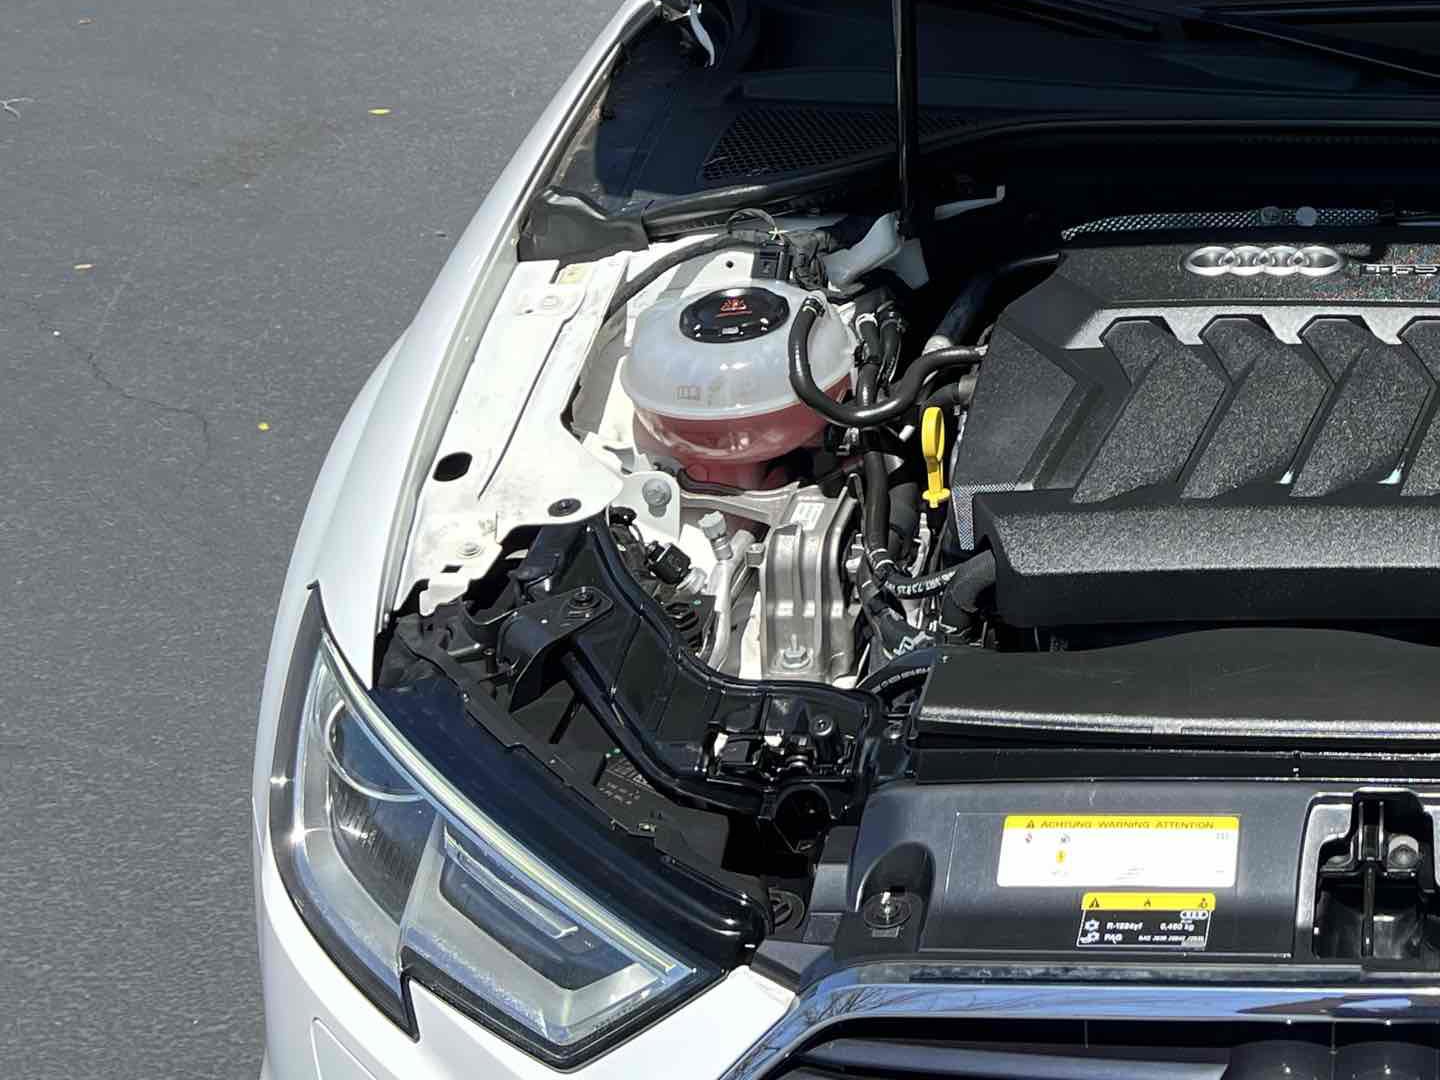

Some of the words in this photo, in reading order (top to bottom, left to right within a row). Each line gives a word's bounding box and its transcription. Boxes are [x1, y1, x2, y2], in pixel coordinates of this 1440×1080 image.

[1040, 820, 1092, 829] ACHTUNG
[1098, 820, 1150, 829] WARNING
[1155, 820, 1214, 829] ATTENTION
